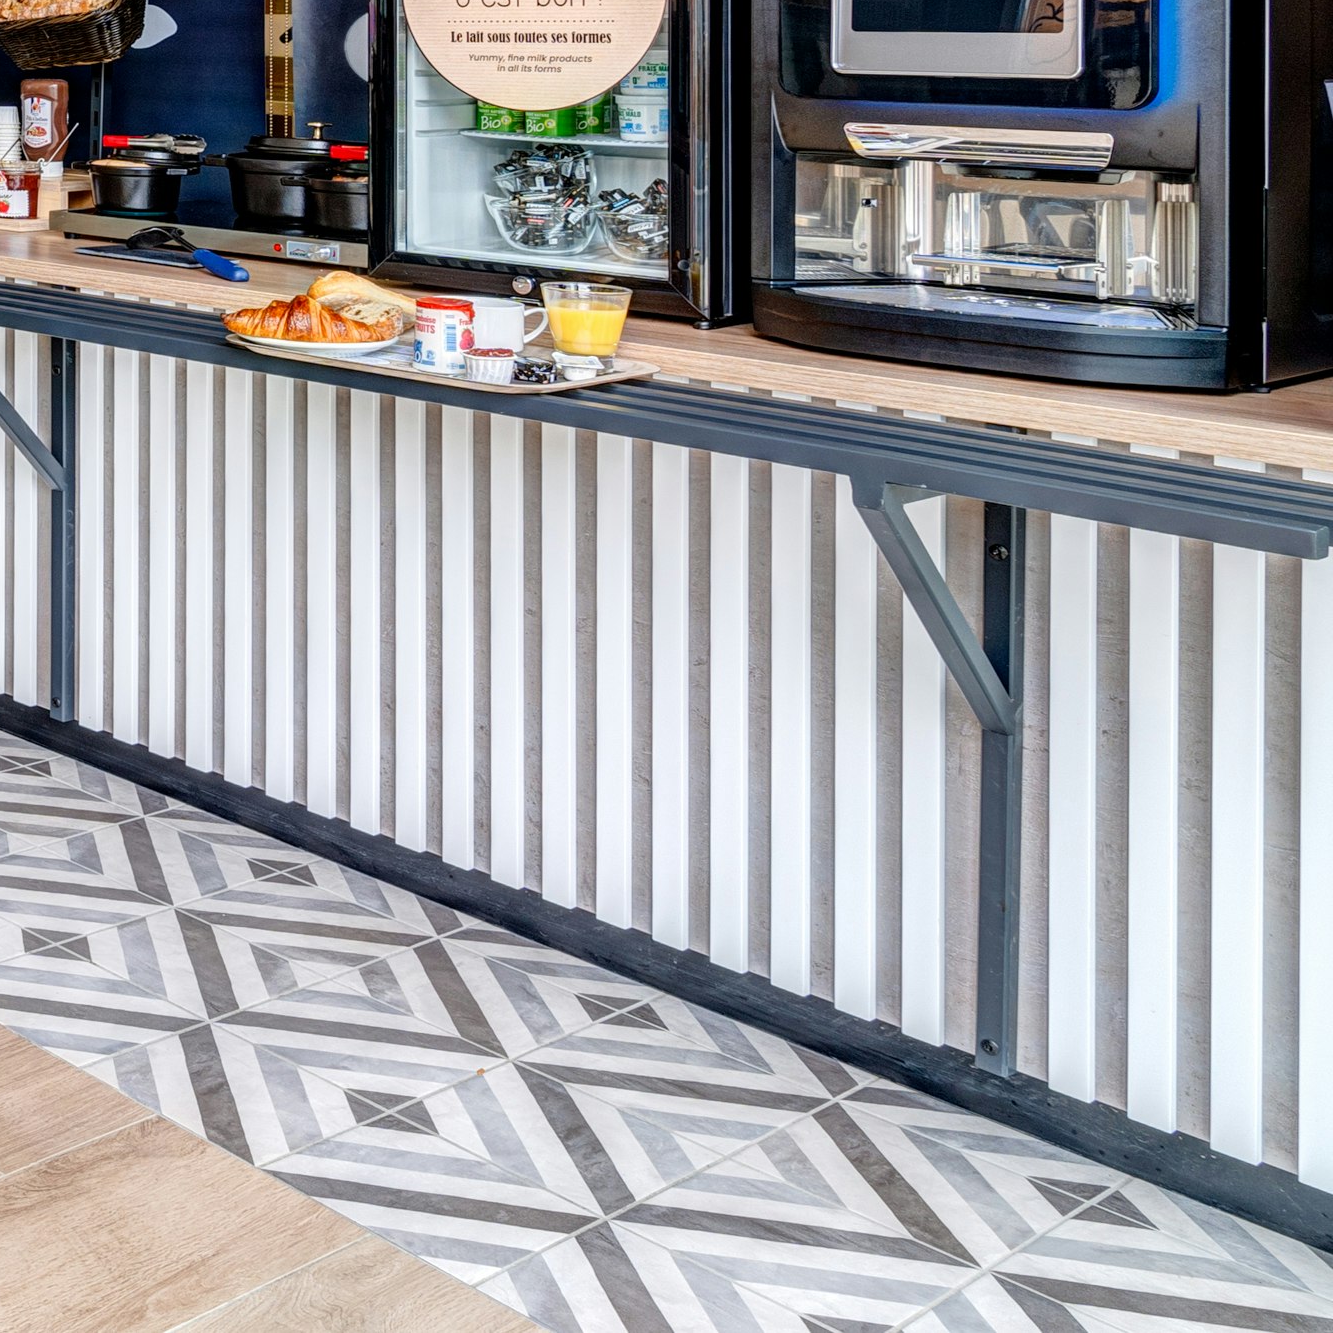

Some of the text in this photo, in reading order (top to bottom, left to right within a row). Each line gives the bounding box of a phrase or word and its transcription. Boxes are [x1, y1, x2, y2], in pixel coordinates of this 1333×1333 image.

[451, 31, 611, 43] Le lait sous toutes ses formes
[469, 54, 592, 64] Yummy, fine milk products
[534, 65, 562, 73] forms
[481, 116, 501, 130] Bio
[526, 119, 545, 133] Bio
